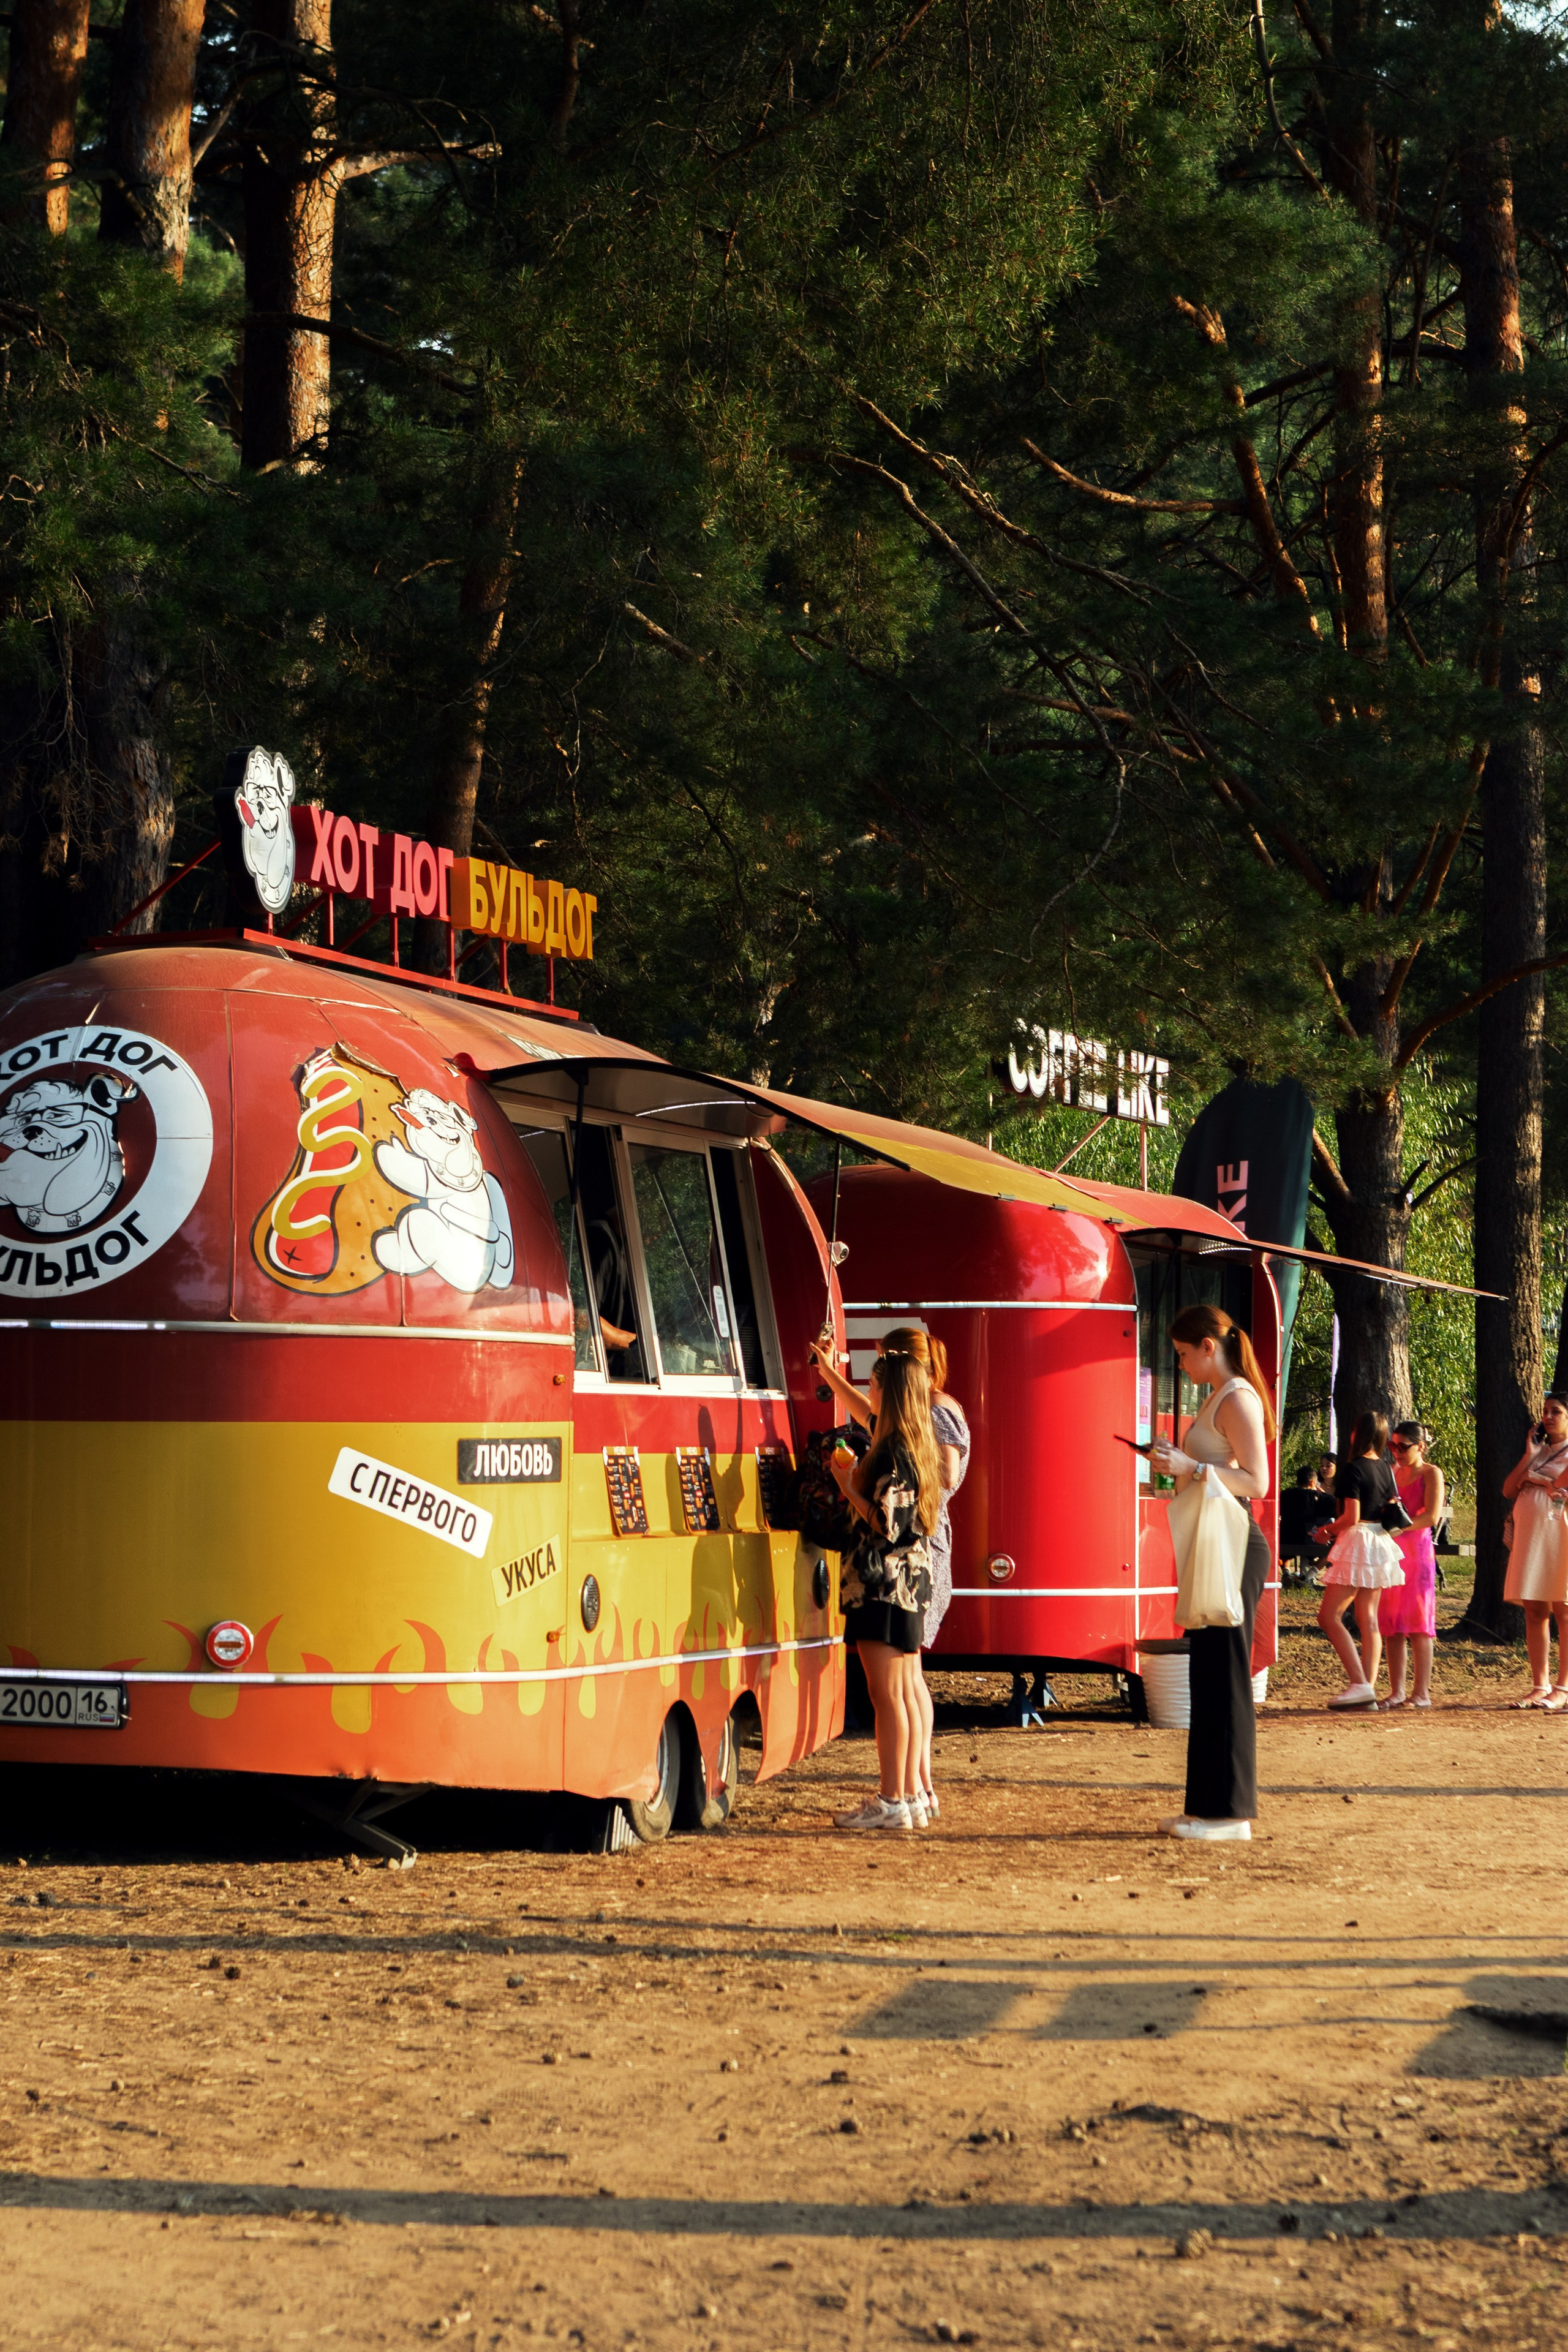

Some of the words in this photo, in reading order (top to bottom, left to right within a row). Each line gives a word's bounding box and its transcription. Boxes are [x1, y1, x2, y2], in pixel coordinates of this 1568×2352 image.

[310, 805, 379, 899] ХОТ
[390, 833, 454, 922] ДОГ
[469, 857, 598, 960] БУЛЬДОГ
[78, 1032, 179, 1075] ДОГ
[1118, 1049, 1170, 1126] LIKE
[473, 1444, 552, 1477] ЛЮБОВЬ
[350, 1463, 369, 1493] С
[368, 1469, 477, 1543] ПЕРВОГО
[500, 1542, 556, 1598] УКУСА
[2, 1688, 72, 1719] 2000
[81, 1691, 108, 1713] 16
[78, 1713, 99, 1722] RUS
